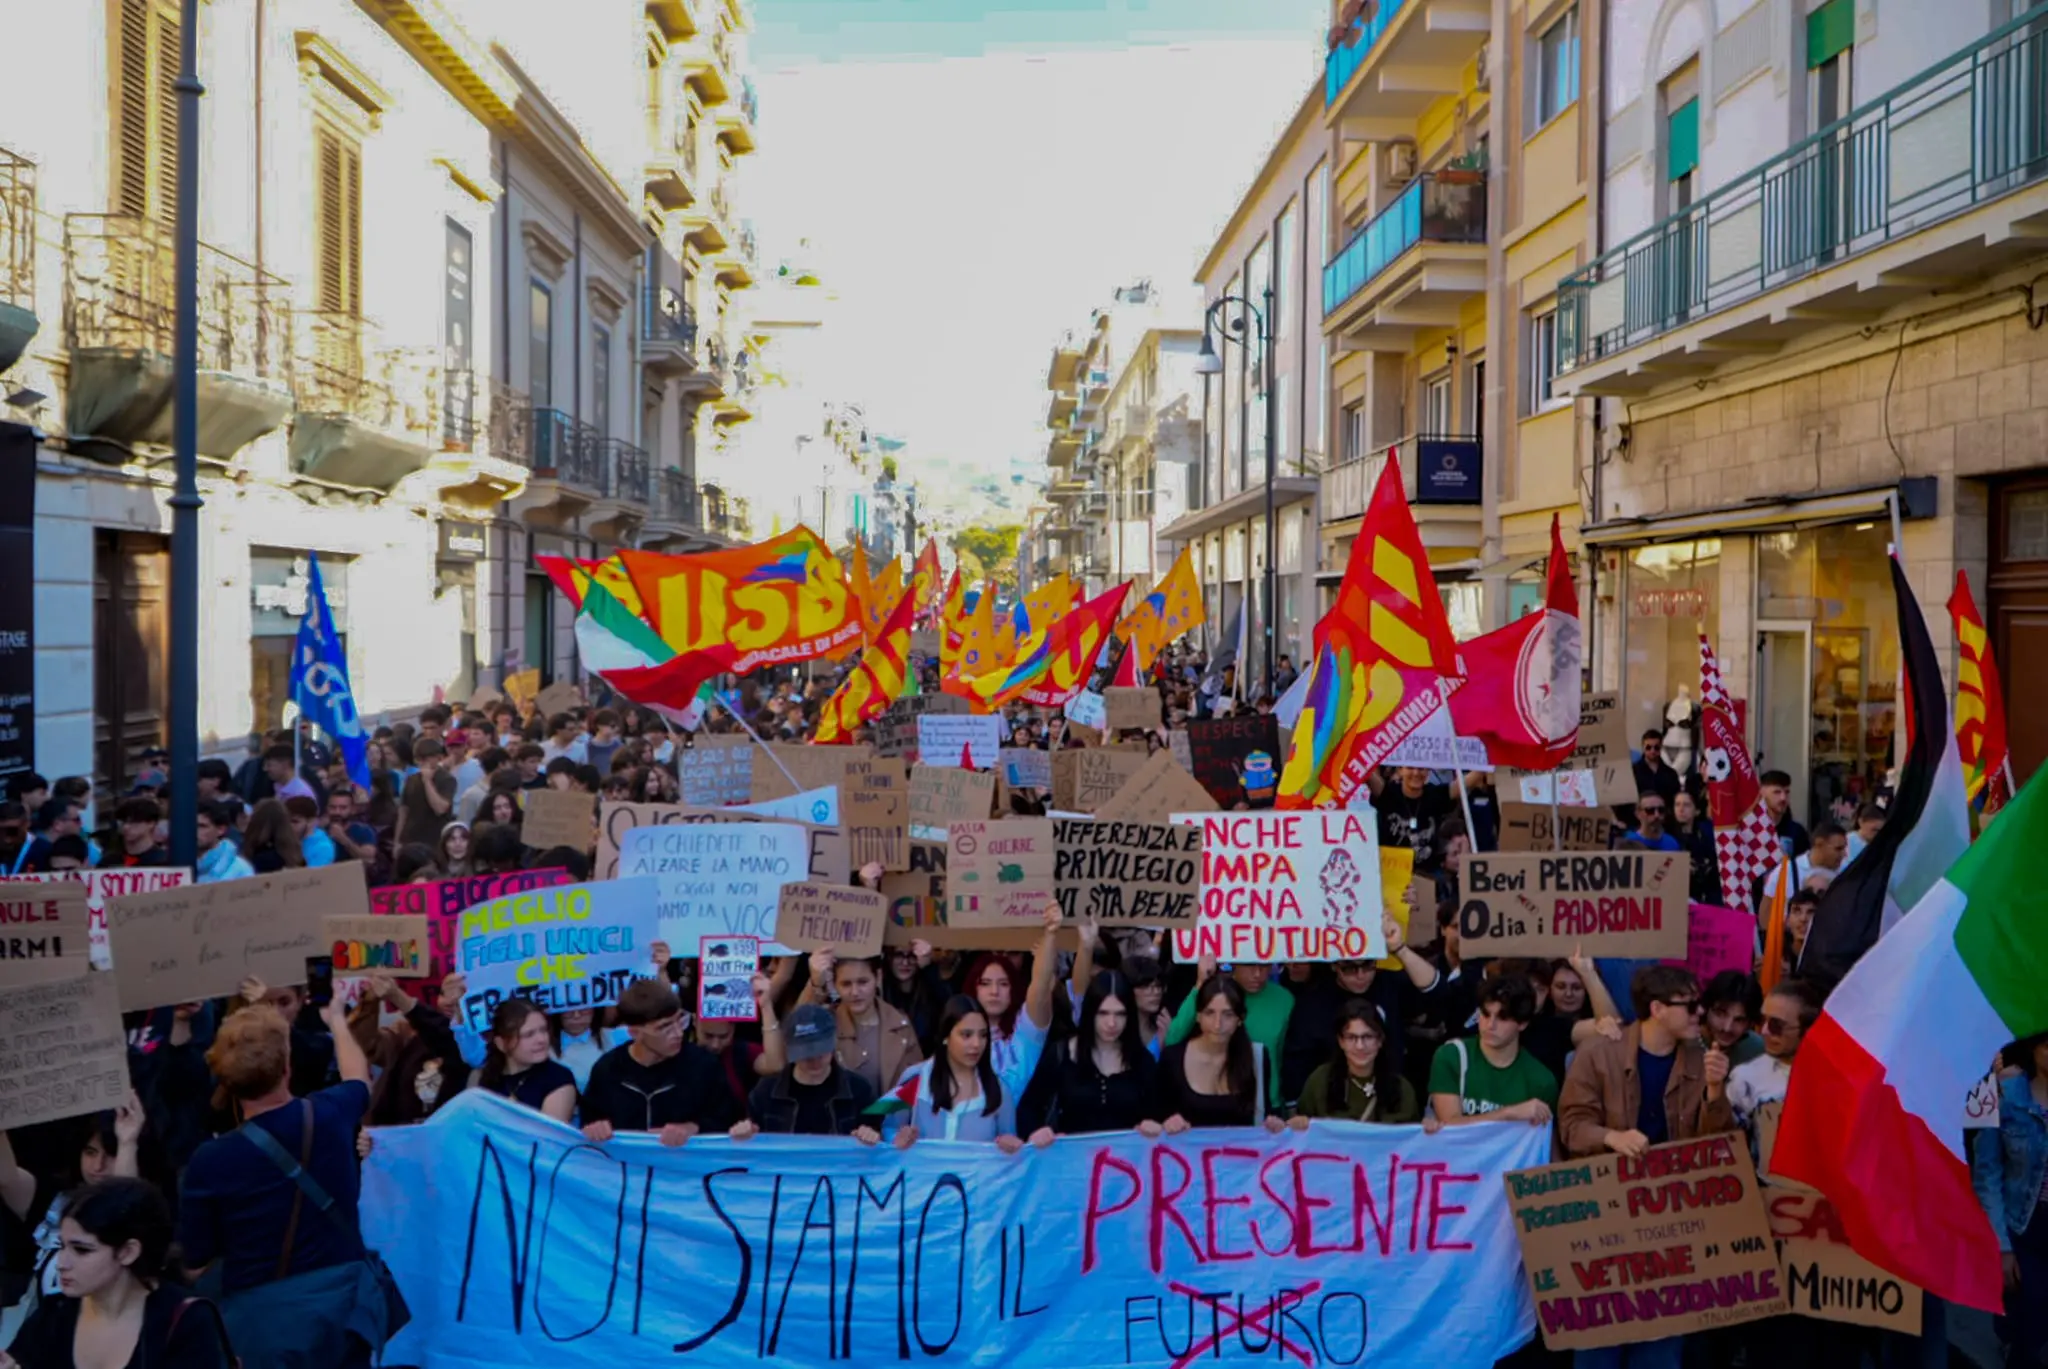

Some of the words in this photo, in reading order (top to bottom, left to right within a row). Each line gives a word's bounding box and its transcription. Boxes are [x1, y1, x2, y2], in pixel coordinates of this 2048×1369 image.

[658, 549, 847, 654] USB
[1191, 720, 1268, 740] RESPECT
[1710, 718, 1752, 779] REGGINA
[664, 833, 743, 853] CHIEDETE
[759, 834, 777, 851] DI
[950, 822, 986, 835] BASTA
[988, 838, 1036, 855] GUERRE
[1322, 813, 1367, 847] LA
[634, 858, 701, 874] ALZARE
[712, 859, 729, 874] LA
[739, 857, 790, 876] MANO
[1054, 849, 1195, 885] PRIVILEGIO
[1198, 851, 1297, 886] IMPA
[1469, 860, 1526, 892] Bevi
[1539, 855, 1644, 892] PERONI
[674, 882, 716, 896] OGGI
[727, 883, 758, 896] NOI
[1130, 889, 1197, 920] BENE
[462, 888, 592, 938] MEGLIO
[697, 902, 717, 918] LA
[722, 905, 776, 938] VOC
[1460, 899, 1527, 939] Odia
[1537, 916, 1544, 934] i
[1552, 897, 1663, 936] PADRONI
[462, 932, 536, 972] FIGLI
[544, 925, 634, 956] UNICI
[1176, 928, 1223, 961] UN
[1232, 926, 1368, 961] FUTURO
[515, 954, 587, 986] CHE
[1080, 1145, 1480, 1276] PRESENTE
[1626, 1173, 1744, 1219] FUTURO
[456, 1133, 655, 1342] NOI
[672, 1166, 970, 1360] SIAMO
[999, 1224, 1049, 1321] IL
[1570, 1240, 1592, 1253] MA
[1599, 1231, 1625, 1248] NON
[1635, 1217, 1706, 1241] TOGLIETEMI
[1533, 1267, 1560, 1293] LE
[1570, 1244, 1696, 1292] VETRINE
[1704, 1244, 1720, 1259] DI
[1730, 1236, 1767, 1252] UNA
[1538, 1268, 1781, 1335] MULTINAZIONALE
[1787, 1262, 1905, 1316] MINIMO
[1125, 1288, 1368, 1366] FUTURO
